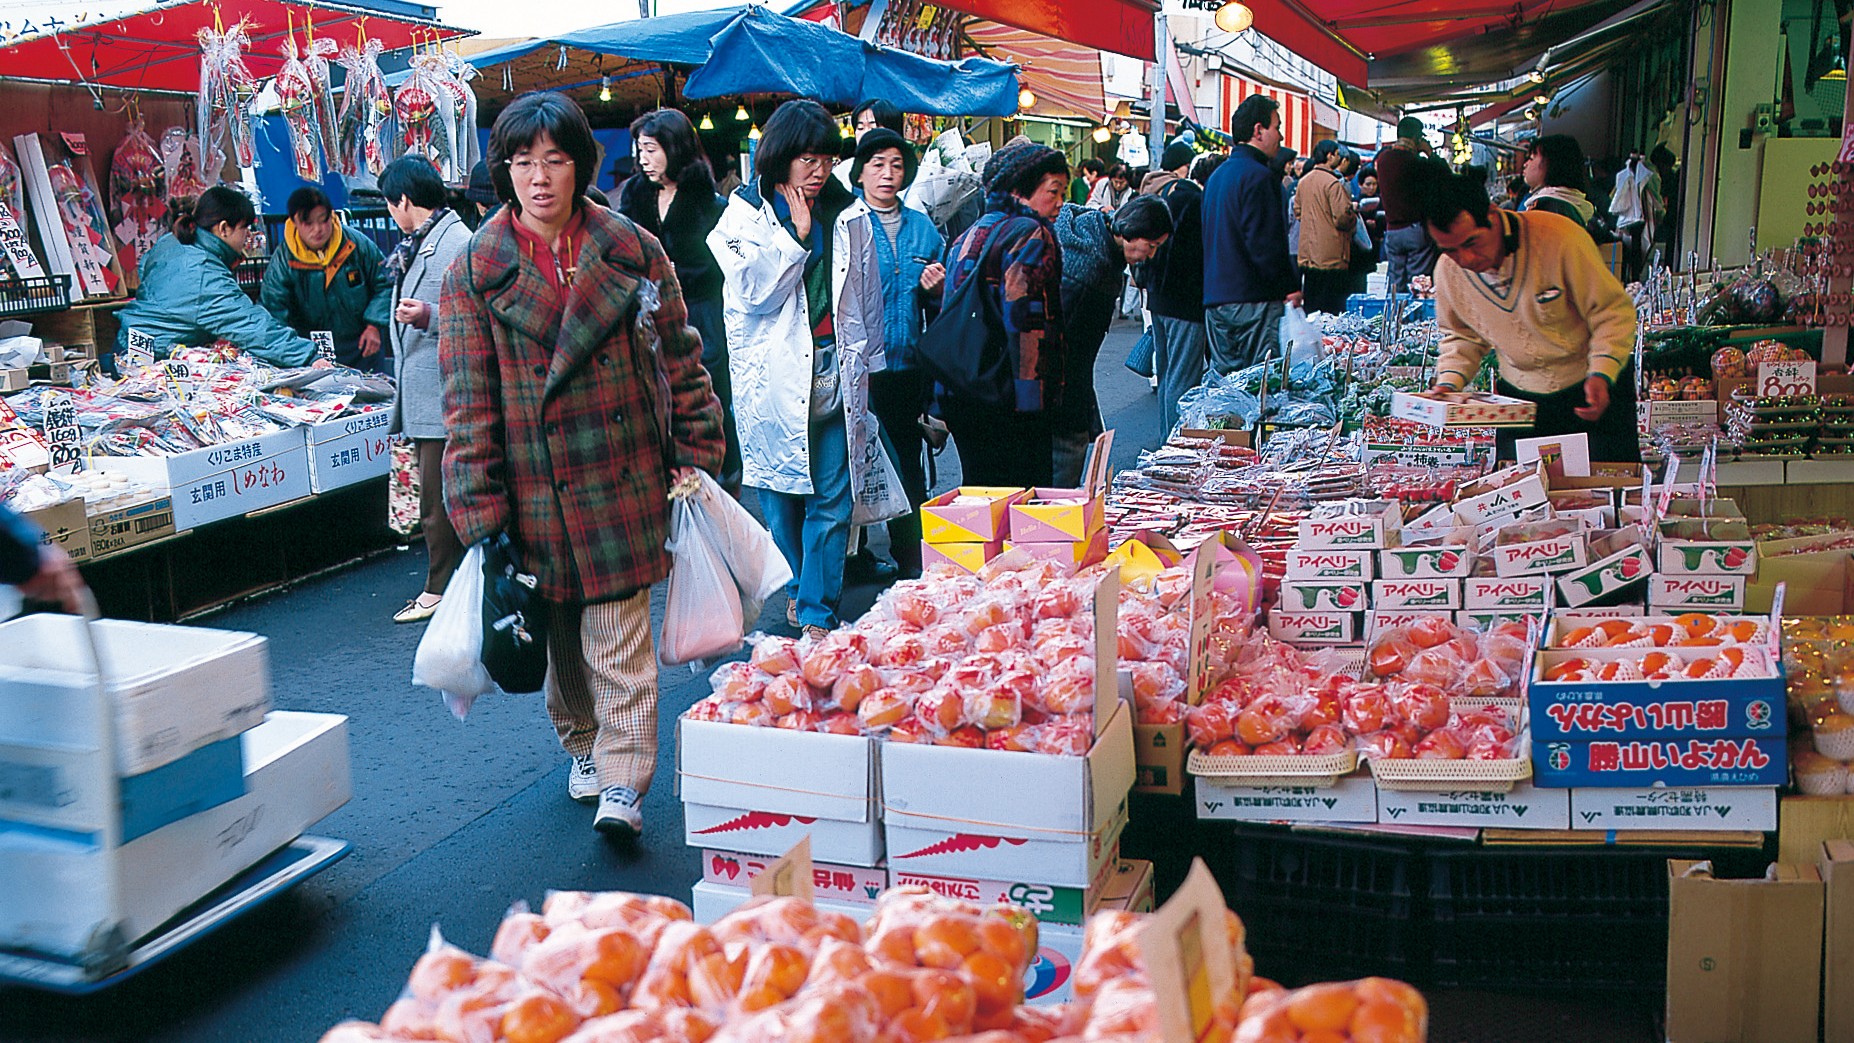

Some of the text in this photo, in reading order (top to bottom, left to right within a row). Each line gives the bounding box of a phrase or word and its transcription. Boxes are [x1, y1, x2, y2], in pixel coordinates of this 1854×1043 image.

[207, 442, 263, 466] くりこま特産
[331, 447, 360, 468] 玄関用
[190, 460, 285, 504] 玄関用 しめなわ
[1310, 522, 1371, 536] アイベリー
[1506, 543, 1570, 562] アイベリー
[1297, 556, 1357, 568] アイベリー
[1383, 583, 1444, 597] アイベリー
[1476, 583, 1540, 597] アイベリー
[1664, 581, 1731, 594] アイベリー
[1280, 616, 1339, 629] アイベリー
[1546, 699, 1729, 732] 勝山いよかん
[1588, 739, 1770, 772] 勝山いよかん
